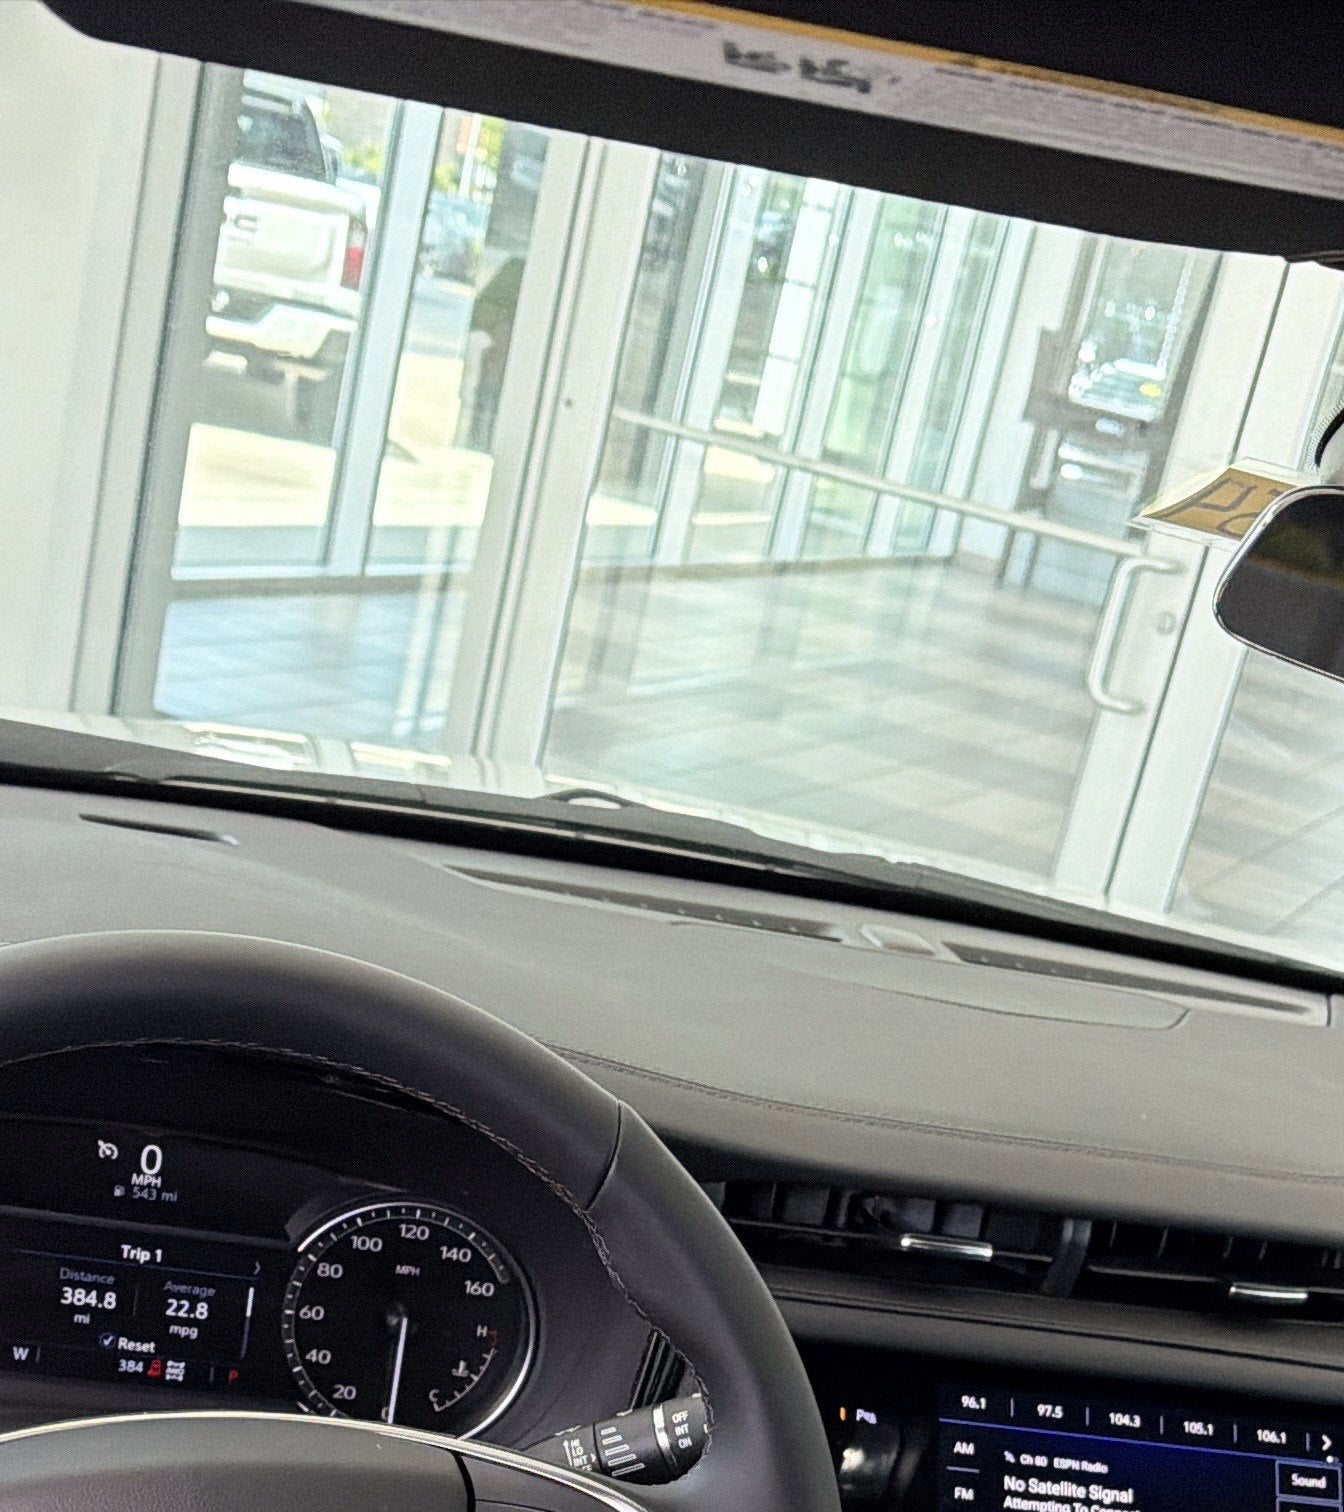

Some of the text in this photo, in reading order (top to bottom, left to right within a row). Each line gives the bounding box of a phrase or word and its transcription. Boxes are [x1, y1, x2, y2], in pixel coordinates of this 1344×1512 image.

[139, 1143, 163, 1175] 0
[130, 1173, 162, 1188] MPH
[132, 1186, 178, 1202] 543 mi
[400, 1223, 430, 1241] 120
[350, 1235, 383, 1253] 100
[120, 1244, 163, 1265] Trip 1
[440, 1246, 472, 1264] 140
[59, 1266, 116, 1286] Distance
[316, 1262, 344, 1279] 80
[395, 1265, 421, 1277] MPH
[60, 1286, 117, 1309] 384.8
[163, 1280, 217, 1298] Average
[464, 1280, 495, 1298] 160
[73, 1311, 91, 1325] mi
[165, 1298, 209, 1321] 22.8
[299, 1305, 325, 1322] 60
[169, 1323, 198, 1340] mpg
[476, 1326, 488, 1338] H
[12, 1347, 29, 1361] W
[117, 1337, 156, 1354] Reset
[305, 1348, 332, 1365] 40
[118, 1359, 144, 1374] 384
[332, 1384, 357, 1401] 20
[429, 1389, 440, 1403] C
[672, 1411, 689, 1425] OFF
[961, 1395, 1287, 1444] 96.1 97.5 104.3 105.1 106.1
[674, 1424, 690, 1437] INT
[678, 1437, 692, 1449] ON
[953, 1441, 975, 1455] AM
[1291, 1472, 1327, 1489] Sound
[954, 1486, 975, 1500] FM
[1003, 1475, 1134, 1505] No Satellite Signal
